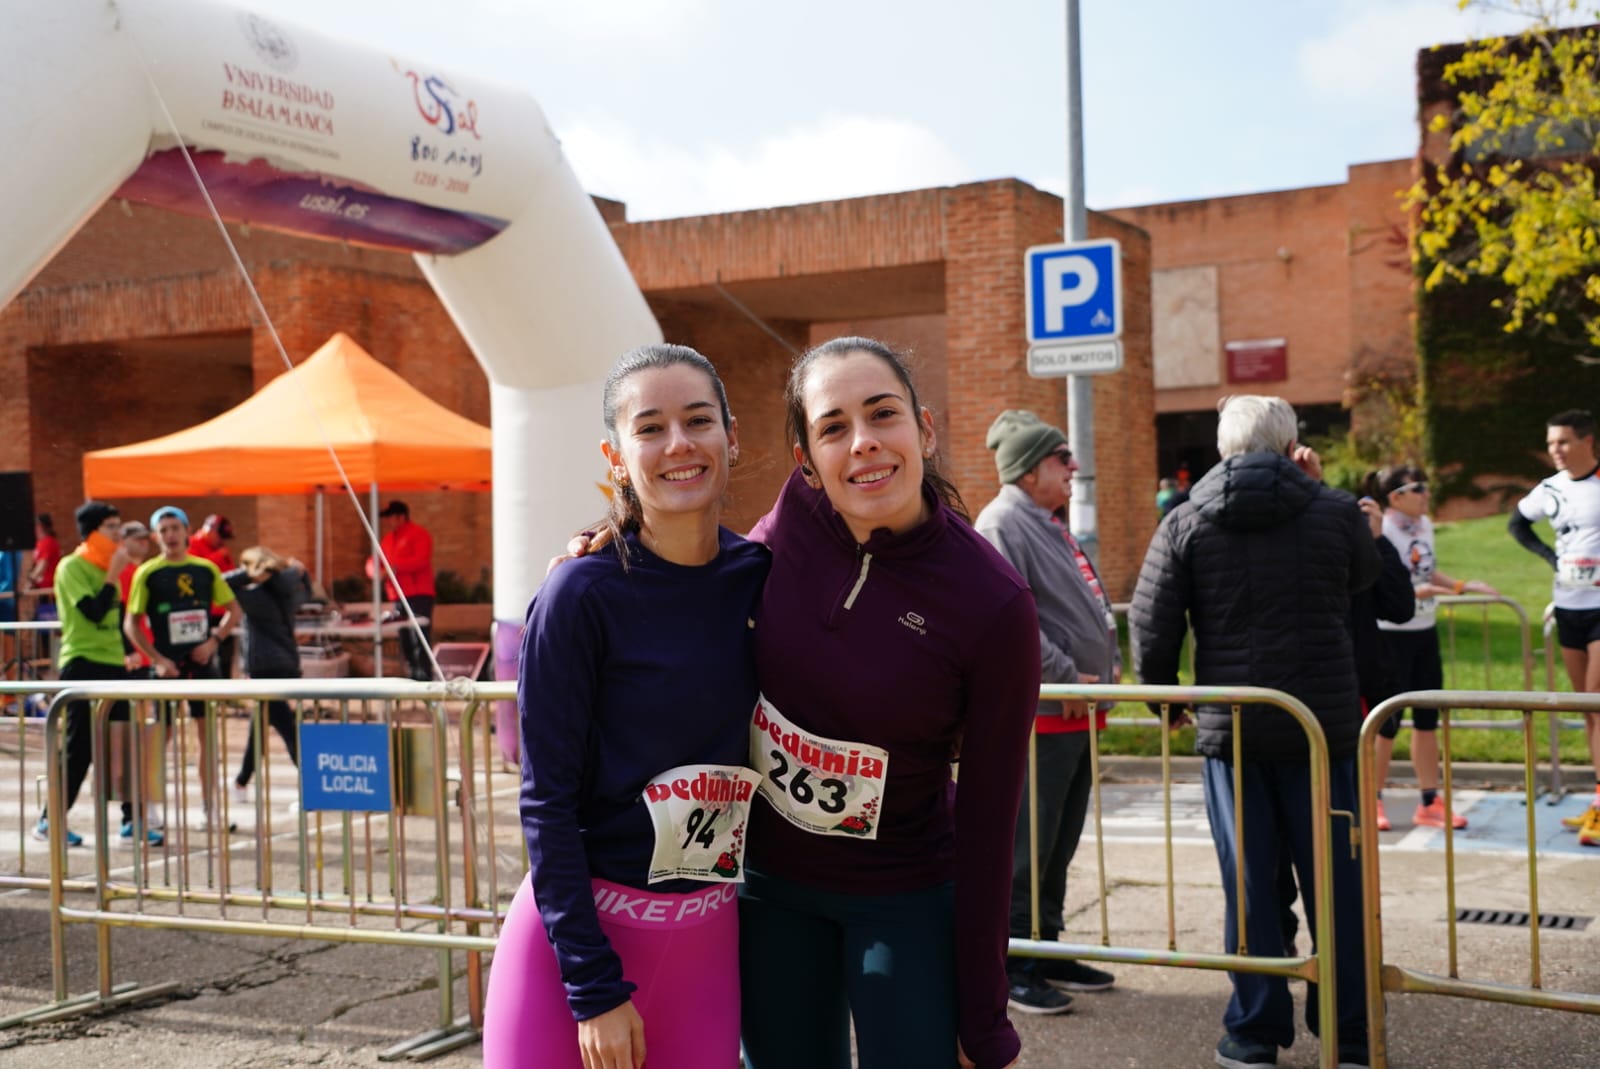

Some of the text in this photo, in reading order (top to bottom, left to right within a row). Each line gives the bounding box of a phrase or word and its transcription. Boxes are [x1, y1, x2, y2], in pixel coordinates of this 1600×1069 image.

[222, 62, 335, 110] VNIVERSIDAD
[300, 192, 370, 220] usal.es
[1042, 254, 1099, 333] P
[753, 702, 883, 779] bedunia
[317, 752, 379, 773] POLICIA
[768, 749, 848, 814] 263
[321, 774, 376, 795] LOCAL
[646, 771, 753, 803] bedunia
[681, 807, 721, 850] 94
